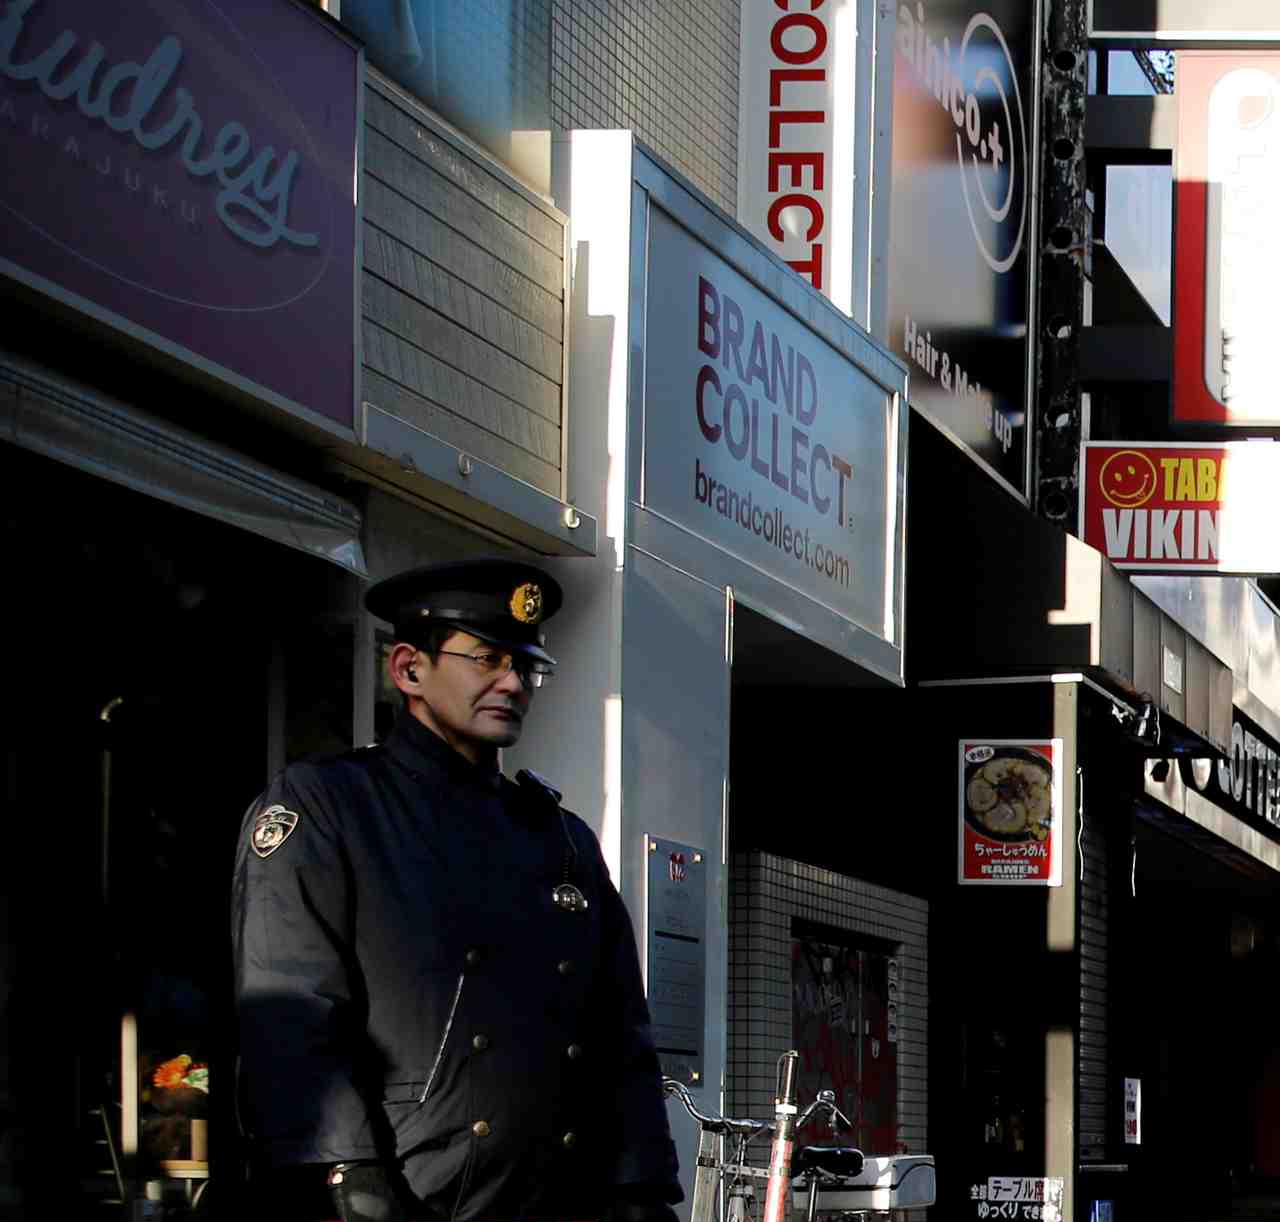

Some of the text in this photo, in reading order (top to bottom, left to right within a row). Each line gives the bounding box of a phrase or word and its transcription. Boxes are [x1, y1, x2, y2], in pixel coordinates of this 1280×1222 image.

[698, 275, 818, 427] BRAND
[904, 314, 939, 379] Hair
[940, 351, 953, 393] &
[994, 408, 1013, 455] up
[695, 363, 852, 528] COLLECT
[695, 458, 850, 587] brandcollect.com
[975, 842, 1048, 860] ちゃーしゅうめん
[980, 864, 1041, 875] RAMEN
